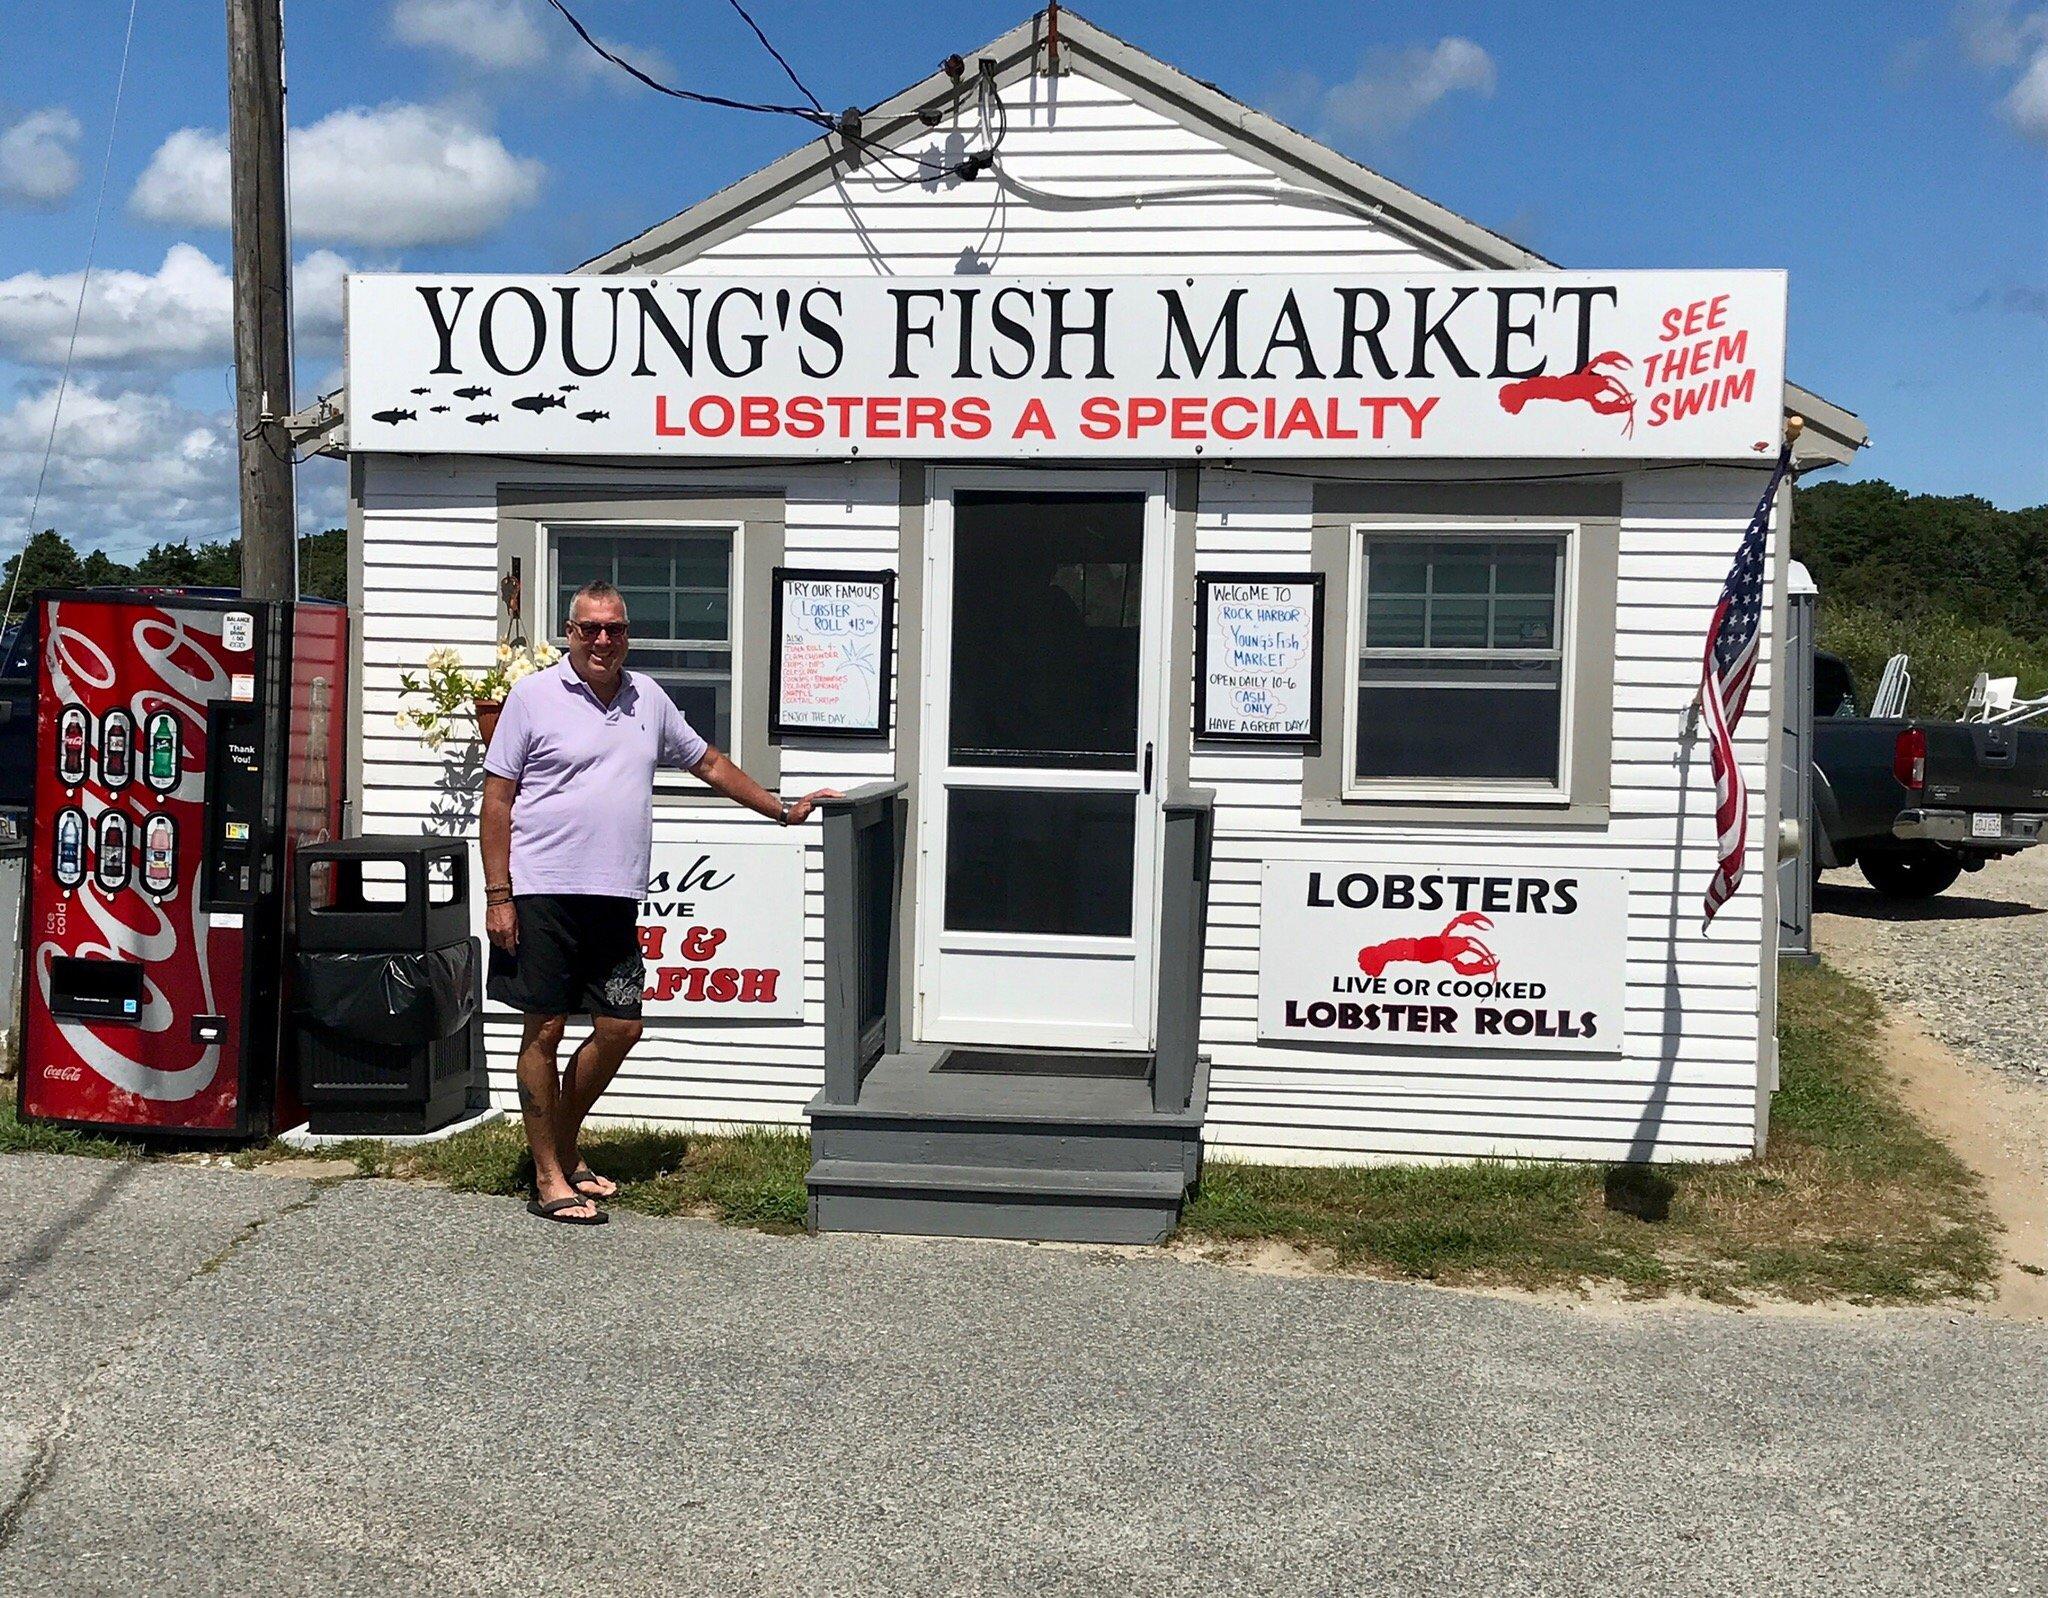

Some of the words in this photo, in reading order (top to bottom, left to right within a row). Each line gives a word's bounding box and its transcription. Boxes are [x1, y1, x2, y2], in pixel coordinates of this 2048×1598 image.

[1659, 294, 1730, 342] SEE
[416, 286, 844, 379] YOUNG'S
[887, 287, 1114, 380] FISH
[1156, 286, 1618, 380] MARKET
[1643, 330, 1748, 388] THEM
[1647, 369, 1756, 426] SWIM
[655, 394, 992, 440] LOBSTERS
[1012, 397, 1056, 441] A
[1080, 396, 1440, 440] SPECIALTY
[786, 582, 809, 597] TRY
[812, 584, 832, 597] OUR
[836, 583, 880, 600] FAMOUS
[1273, 585, 1291, 602] TO
[802, 600, 850, 618] LOBSTER
[1224, 606, 1253, 621] ROCK
[1257, 608, 1300, 622] HARBOR
[815, 617, 842, 631] ROLL
[1234, 650, 1285, 667] MARKET
[1210, 674, 1236, 686] OPEN
[1239, 676, 1267, 688] DAILY
[1272, 677, 1297, 689] 10-6
[1235, 691, 1266, 702] CASH
[782, 710, 808, 722] ENJOY
[812, 711, 826, 722] THE
[828, 713, 846, 724] DAY
[1244, 703, 1273, 715] ONLY
[1209, 718, 1235, 731] HAVE
[1241, 721, 1250, 732] A
[1250, 720, 1281, 732] GREAT
[1286, 719, 1309, 732] DAY!
[229, 744, 255, 754] Thank
[232, 755, 251, 764] You!
[1306, 872, 1579, 915] LOBSTERS
[45, 912, 56, 934] ice
[57, 903, 67, 936] cold
[680, 925, 727, 962] &
[1332, 976, 1387, 994] LIVE
[1394, 979, 1430, 997] OR
[1437, 980, 1547, 1000] COOKED
[1285, 1000, 1459, 1034] LOBSTER
[1474, 1007, 1599, 1039] ROLLS
